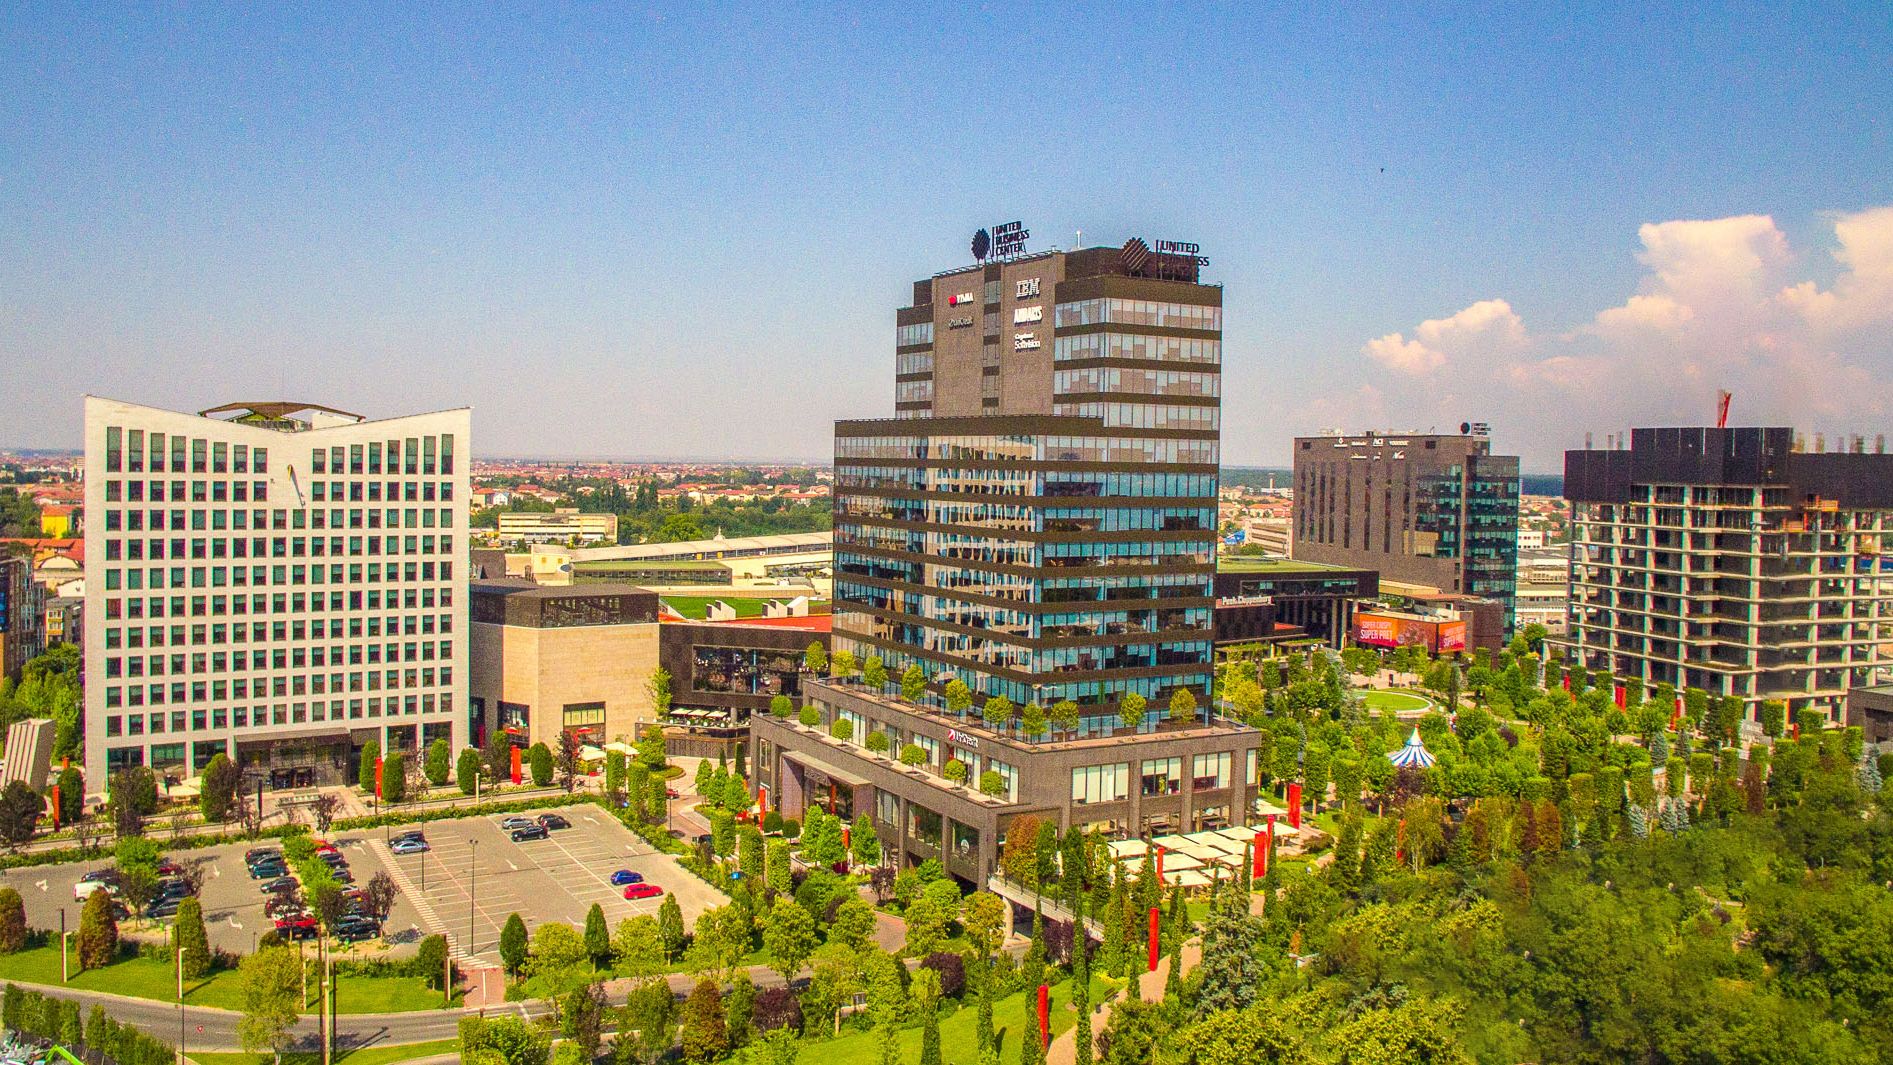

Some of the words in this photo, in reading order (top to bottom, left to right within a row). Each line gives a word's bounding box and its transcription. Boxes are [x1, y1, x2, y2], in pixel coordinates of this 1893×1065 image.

[996, 221, 1021, 234] UNITED
[996, 230, 1029, 245] BUSINESS
[996, 243, 1023, 255] CENTER
[1160, 240, 1200, 254] UNITED
[1016, 277, 1040, 297] IBM
[1360, 629, 1378, 640] SUPER
